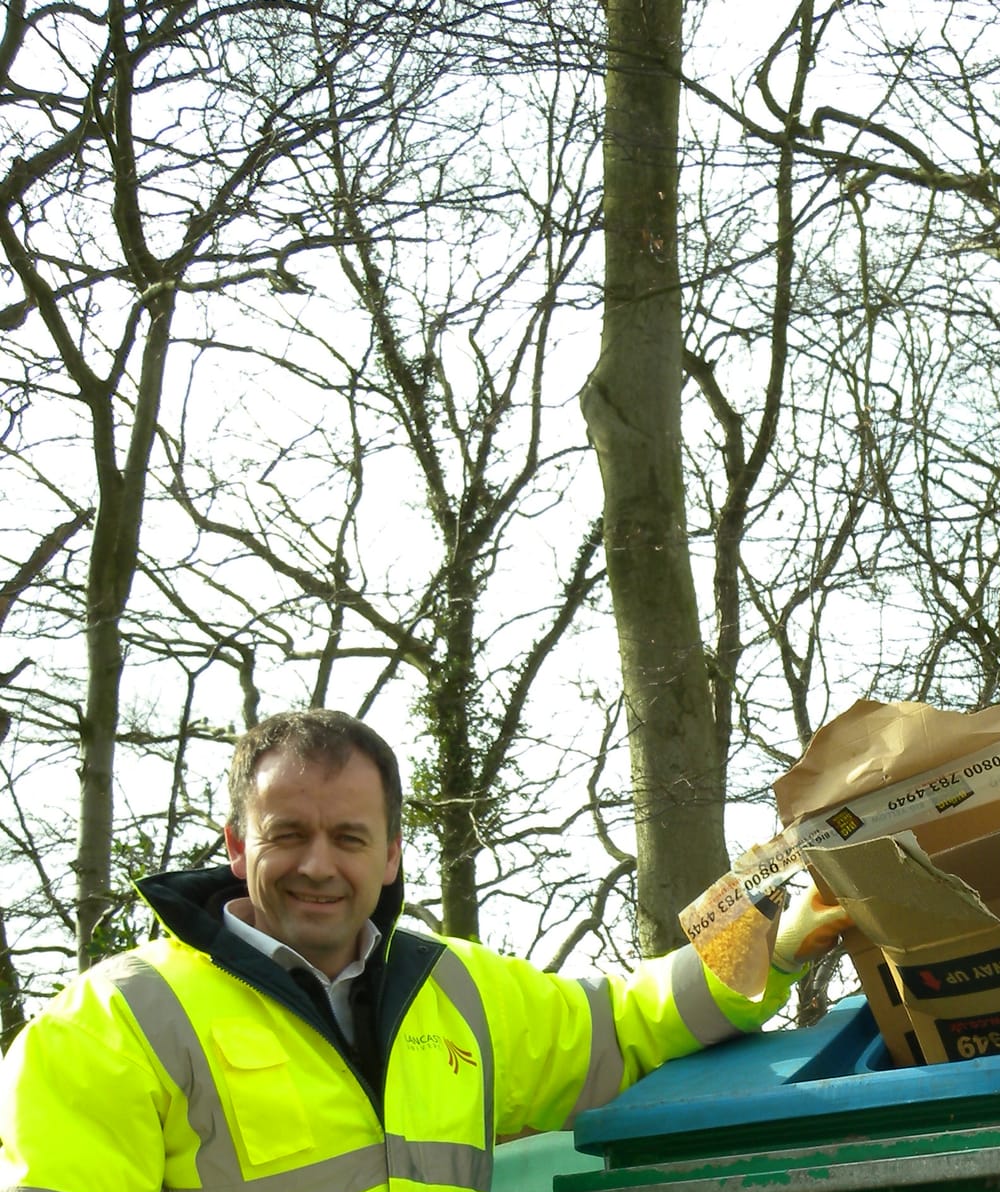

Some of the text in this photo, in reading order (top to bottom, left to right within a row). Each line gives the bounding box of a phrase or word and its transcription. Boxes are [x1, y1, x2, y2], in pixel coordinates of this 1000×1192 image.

[929, 773, 961, 793] 783
[887, 788, 926, 811] 4949
[743, 862, 780, 892] 0800
[717, 888, 744, 914] 783
[945, 969, 974, 985] UP
